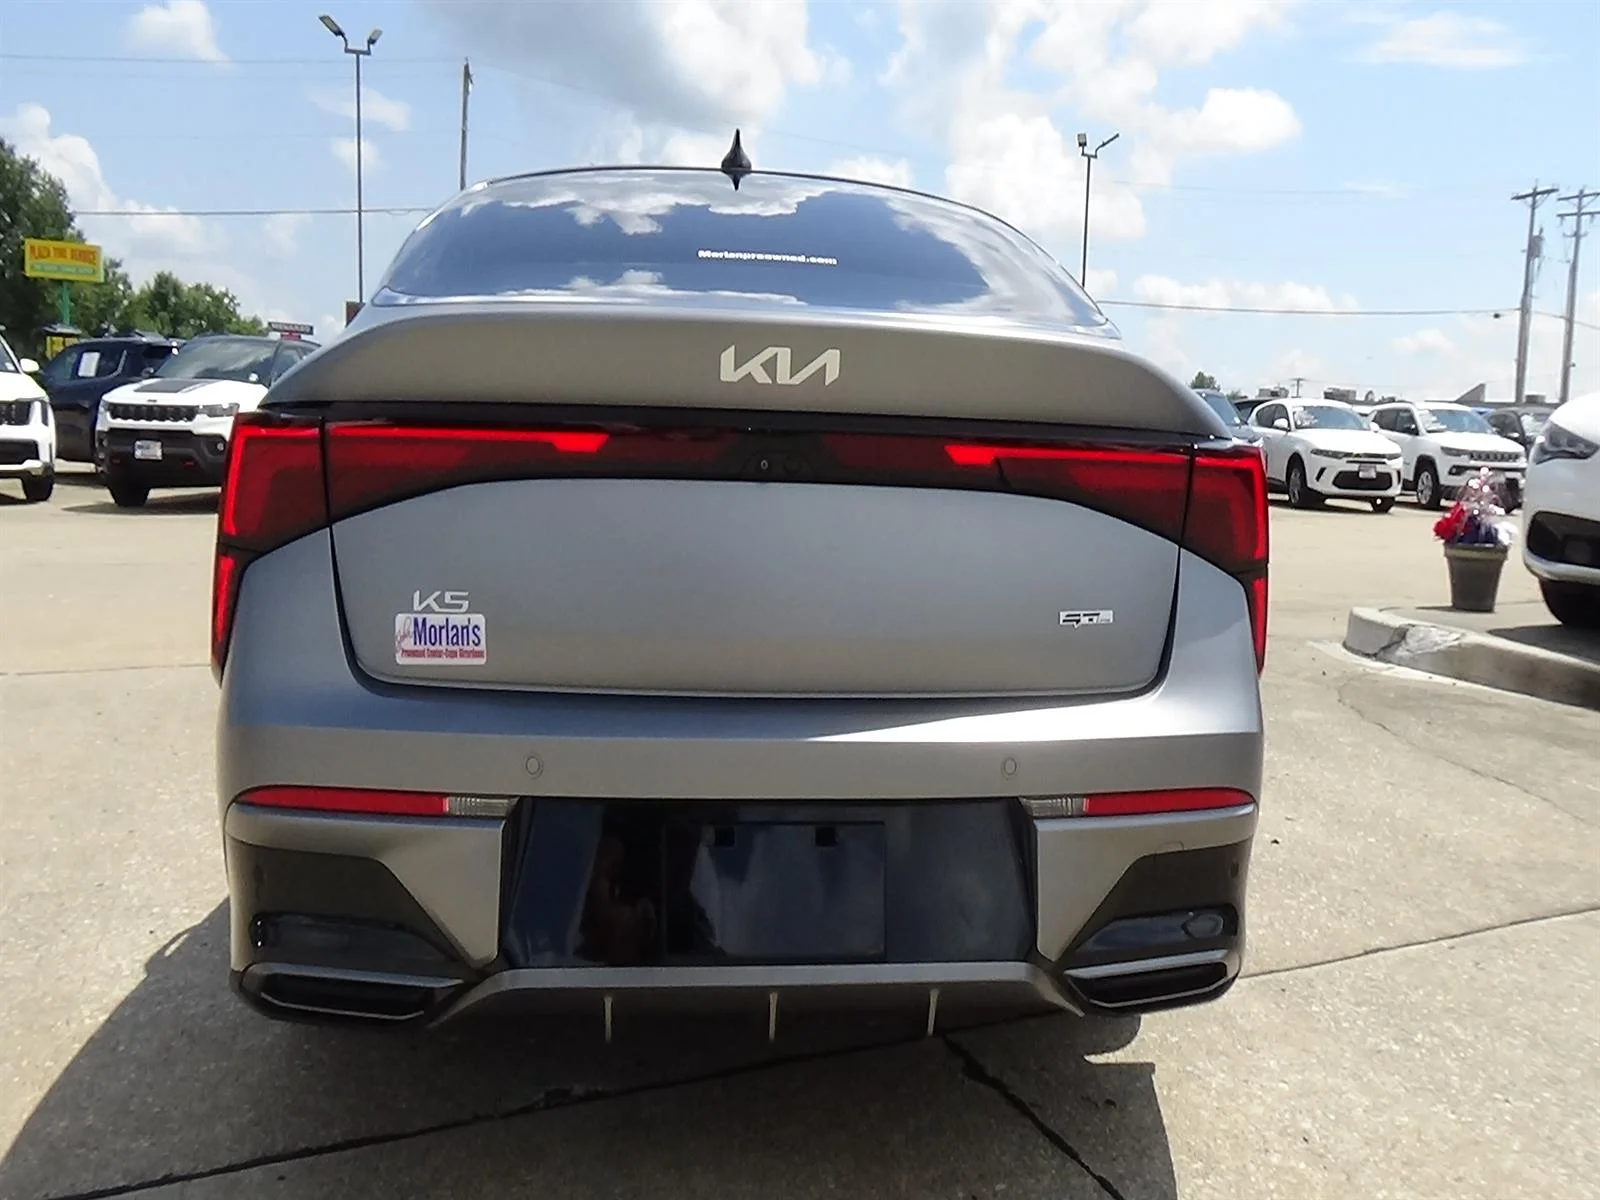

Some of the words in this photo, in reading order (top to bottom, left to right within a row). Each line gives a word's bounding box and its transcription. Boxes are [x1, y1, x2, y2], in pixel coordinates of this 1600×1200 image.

[720, 344, 841, 387] KIA
[413, 590, 469, 612] K5
[414, 616, 481, 646] Morlan's
